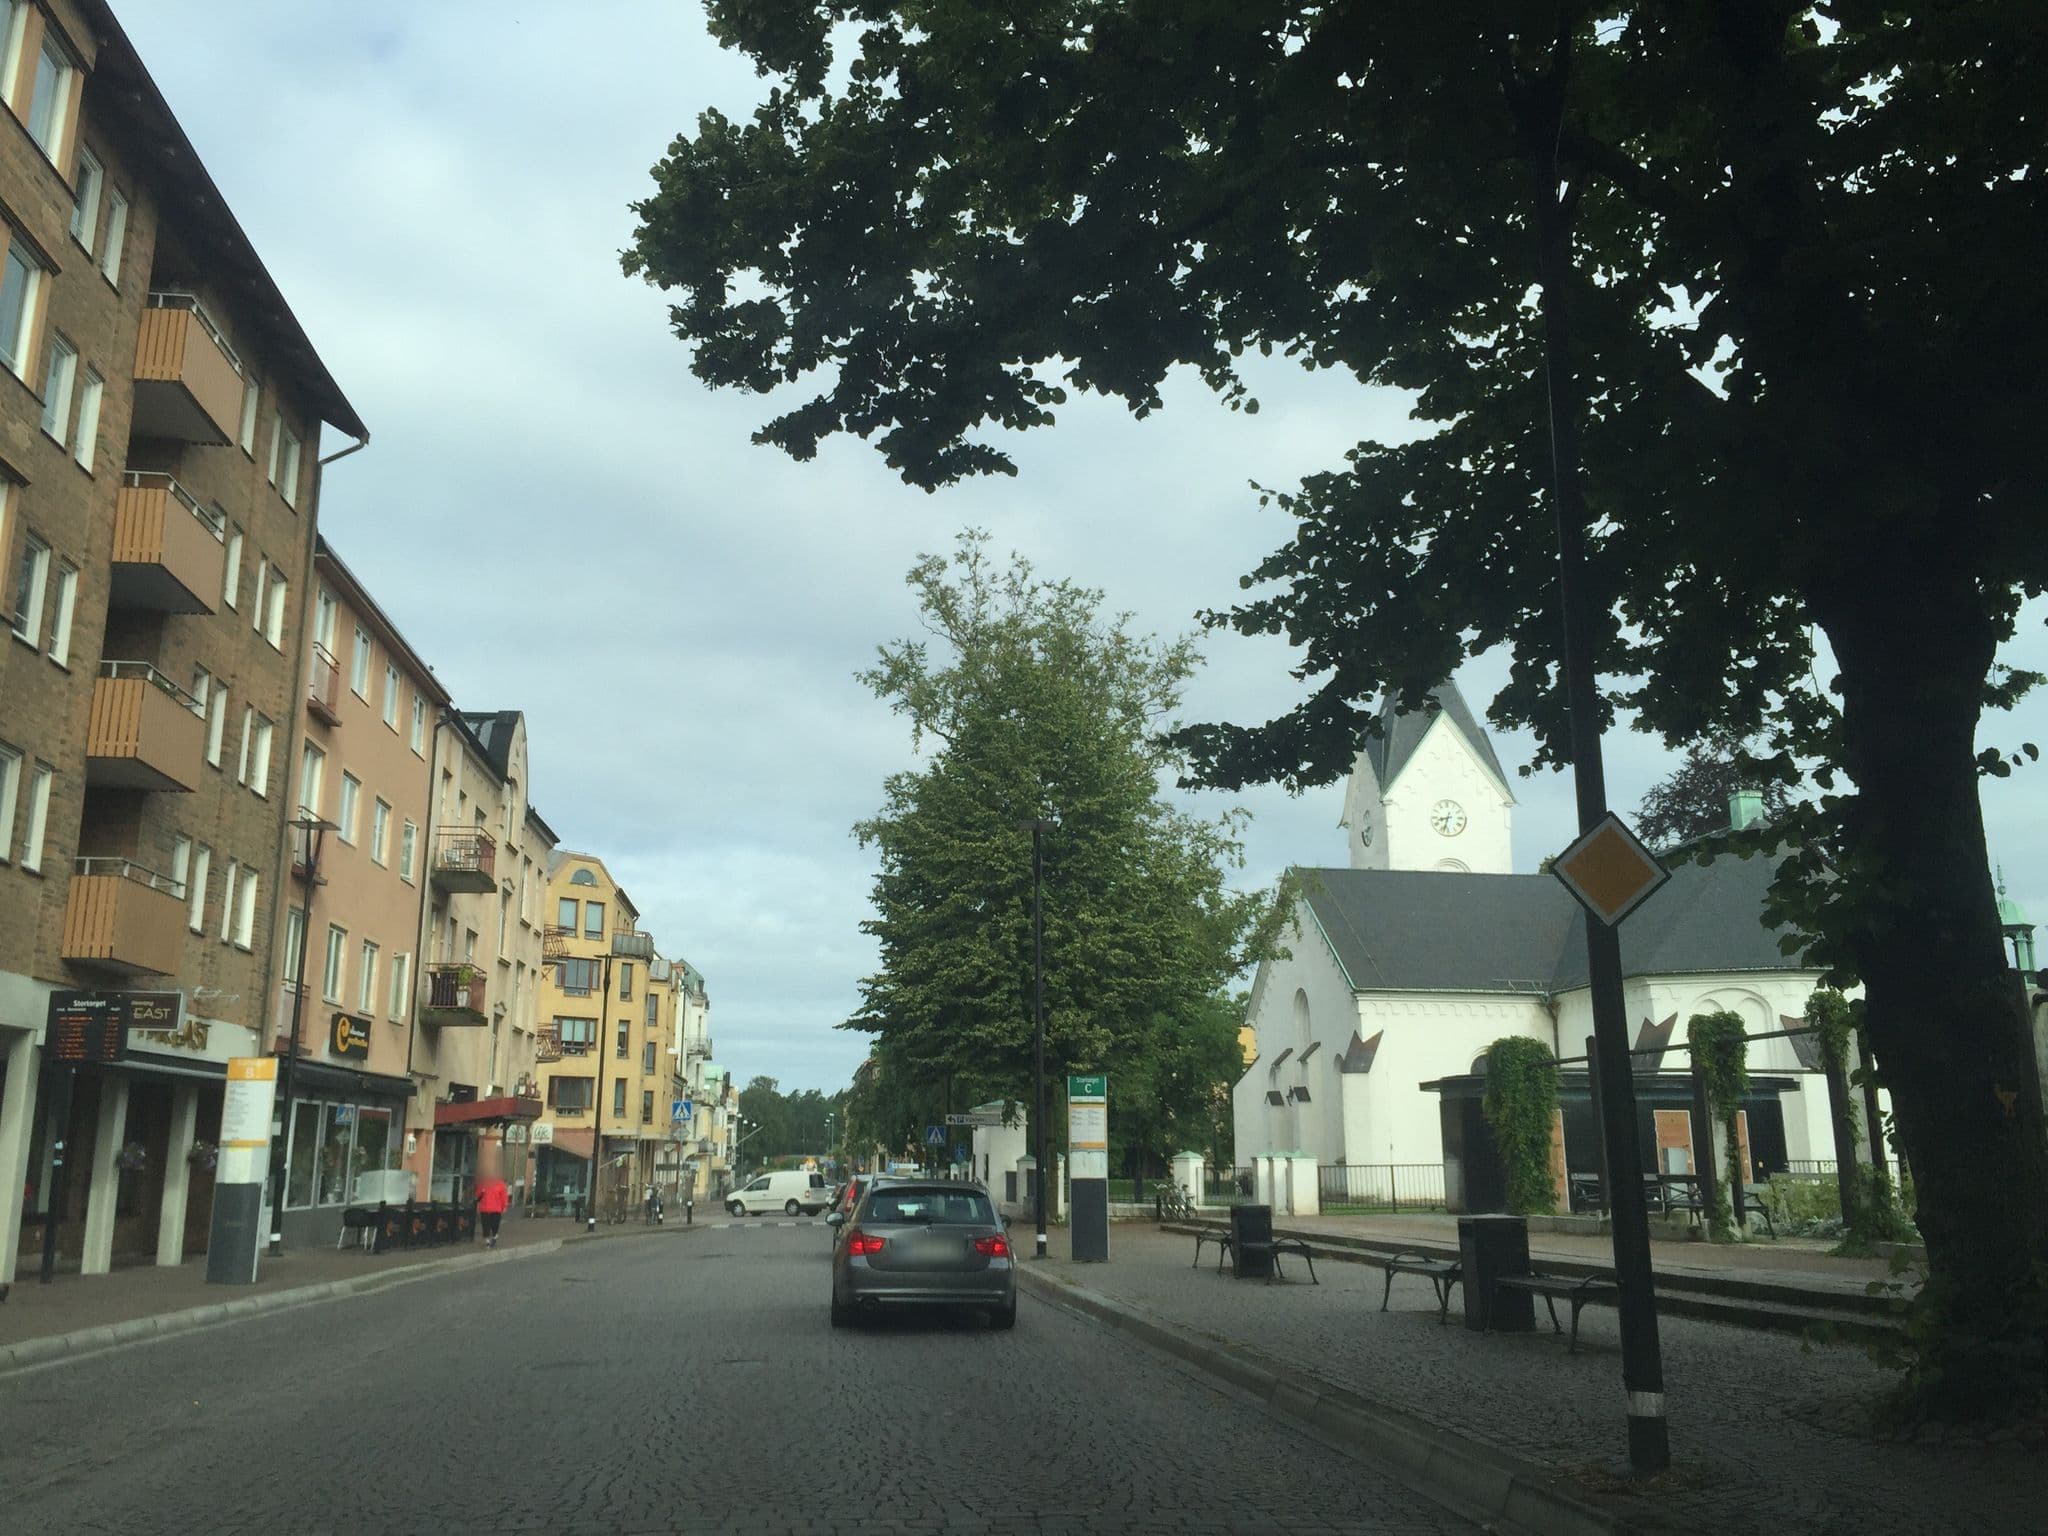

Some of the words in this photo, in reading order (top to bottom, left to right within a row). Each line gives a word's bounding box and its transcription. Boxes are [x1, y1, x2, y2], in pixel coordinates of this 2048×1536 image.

[73, 1000, 106, 1008] Stortorget
[133, 1007, 171, 1020] EAST
[1084, 1083, 1093, 1094] C
